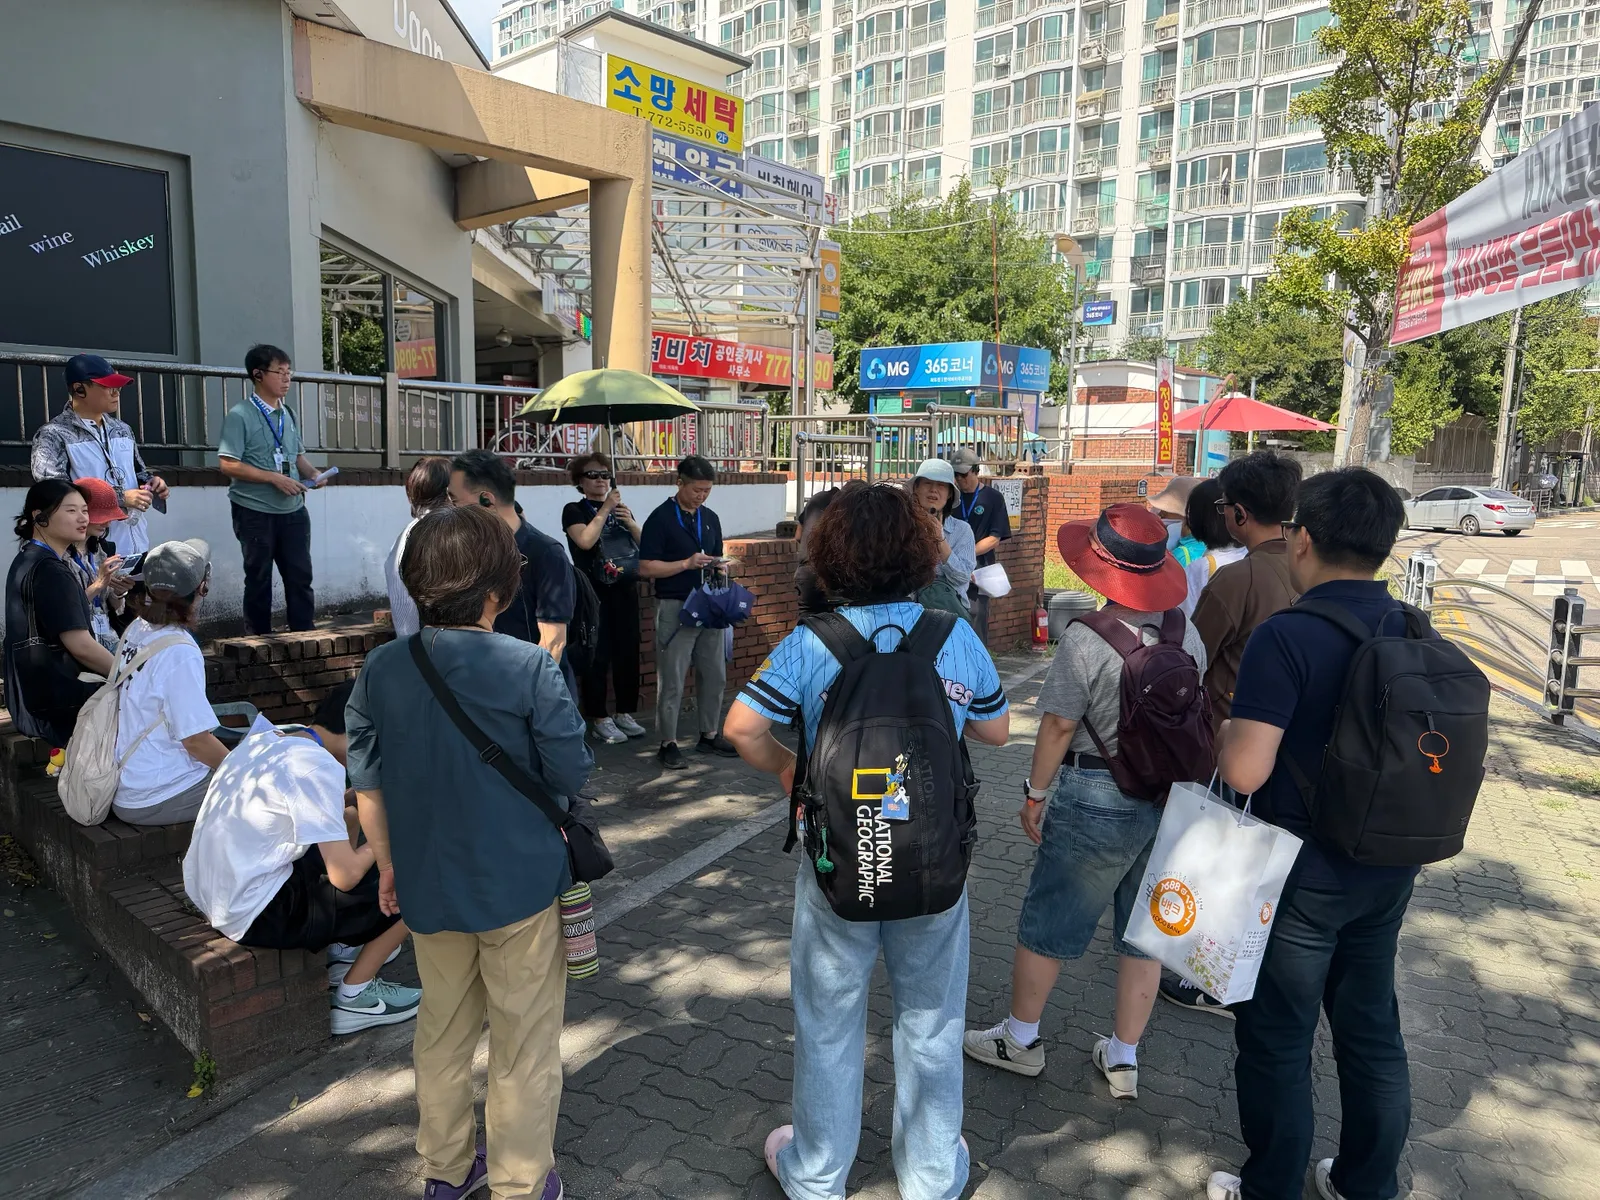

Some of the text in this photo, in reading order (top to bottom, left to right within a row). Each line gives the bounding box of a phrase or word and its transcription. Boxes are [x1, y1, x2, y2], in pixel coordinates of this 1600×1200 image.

[613, 65, 737, 132] 소망세탁
[824, 194, 838, 224] 약
[0, 214, 23, 237] ail
[28, 231, 75, 254] wine
[81, 233, 156, 269] Whiskey
[715, 344, 763, 366] 공인중개사
[765, 353, 830, 383] 777990
[727, 364, 750, 378] 사무소
[887, 361, 910, 377] MG
[1000, 360, 1013, 375] MG
[1160, 387, 1172, 460] 정육점
[856, 805, 874, 902] GEOGRAPHIC
[873, 806, 893, 886] NATIONAL
[1161, 897, 1181, 916] 뱅크
